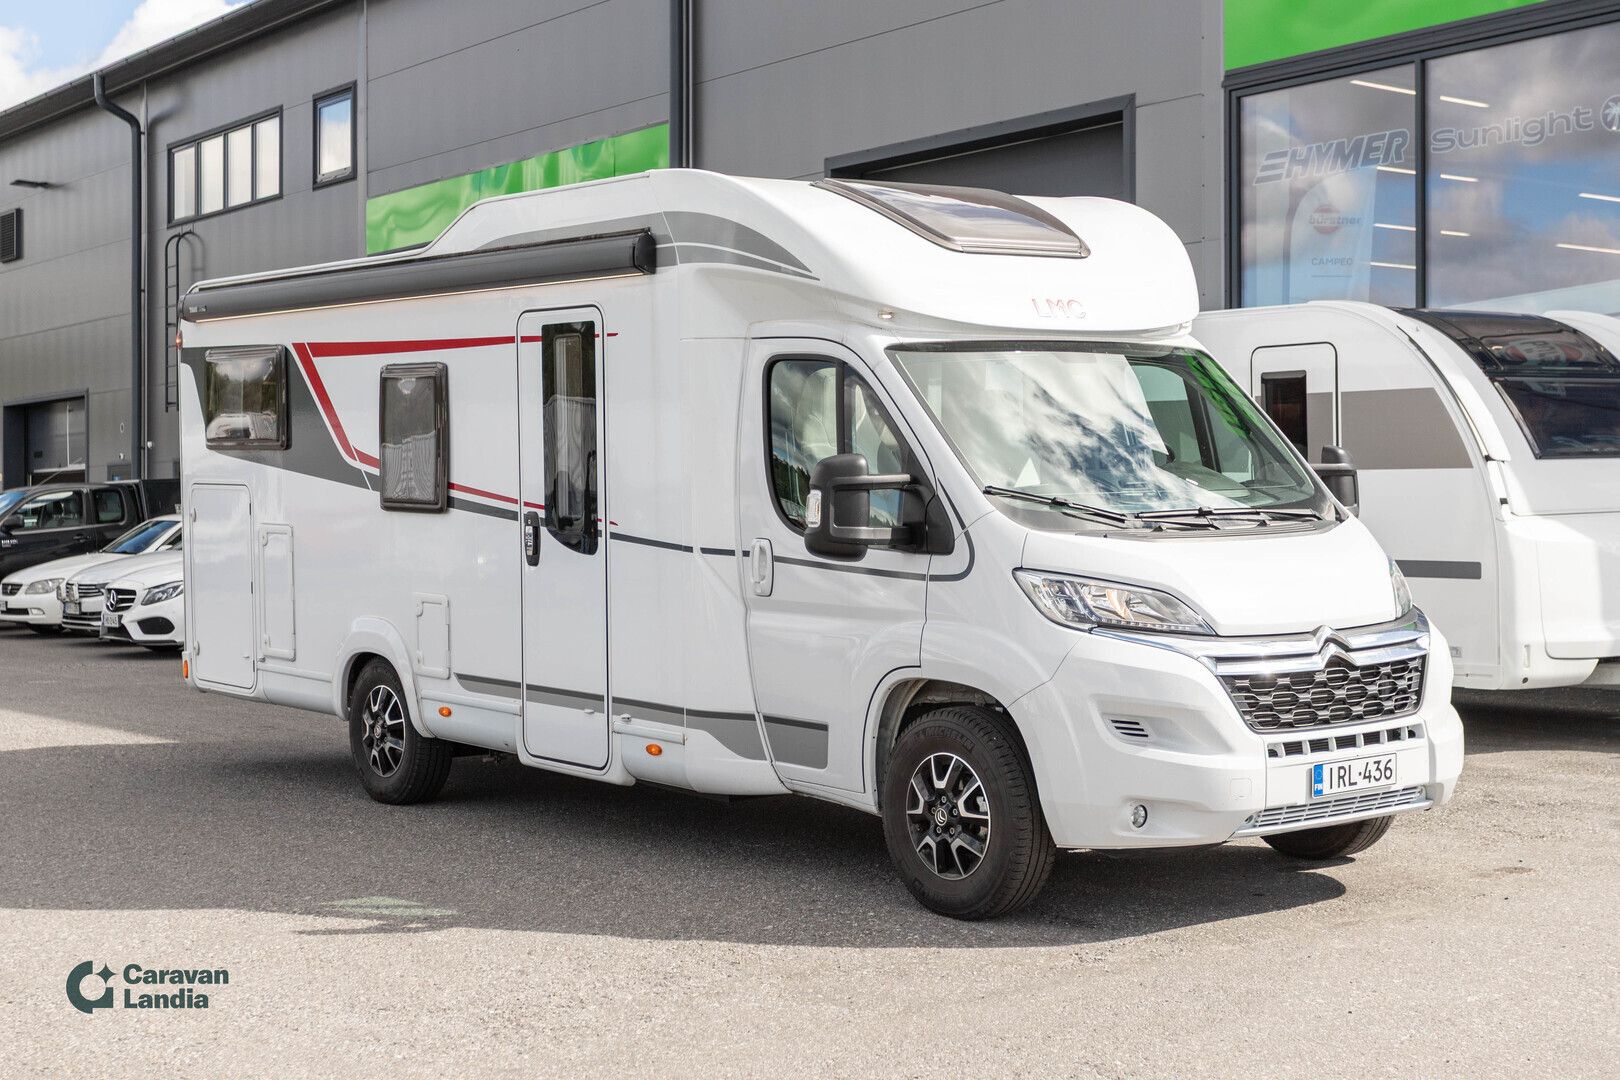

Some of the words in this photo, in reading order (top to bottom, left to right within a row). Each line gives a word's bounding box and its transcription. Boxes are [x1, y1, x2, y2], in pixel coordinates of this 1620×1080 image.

[1431, 106, 1594, 154] Sunlight
[1284, 129, 1410, 179] HYMER
[1031, 298, 1086, 319] LMC
[1330, 759, 1392, 789] IRL-436
